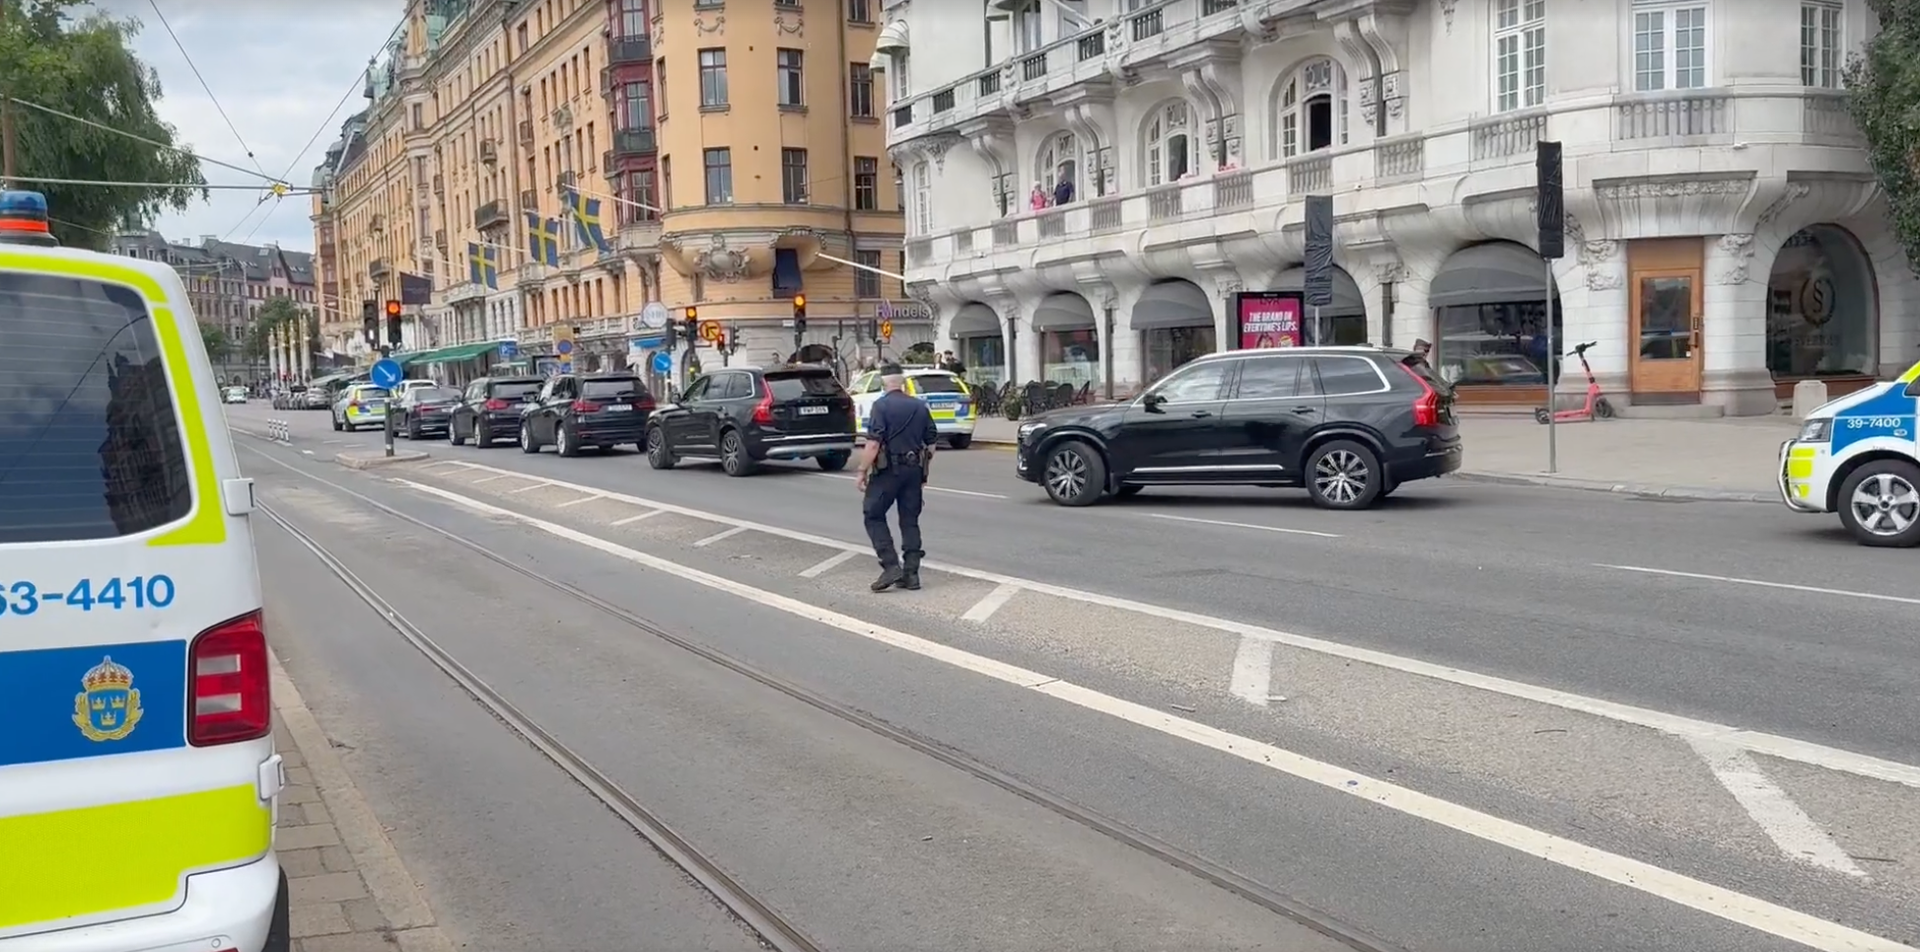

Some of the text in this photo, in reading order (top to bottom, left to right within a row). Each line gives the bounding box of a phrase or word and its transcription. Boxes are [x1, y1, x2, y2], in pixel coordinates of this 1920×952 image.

[1249, 311, 1262, 322] THE
[1262, 310, 1284, 322] BRAND
[1847, 418, 1901, 429] 39-7400
[0, 574, 175, 616] 3-4410
